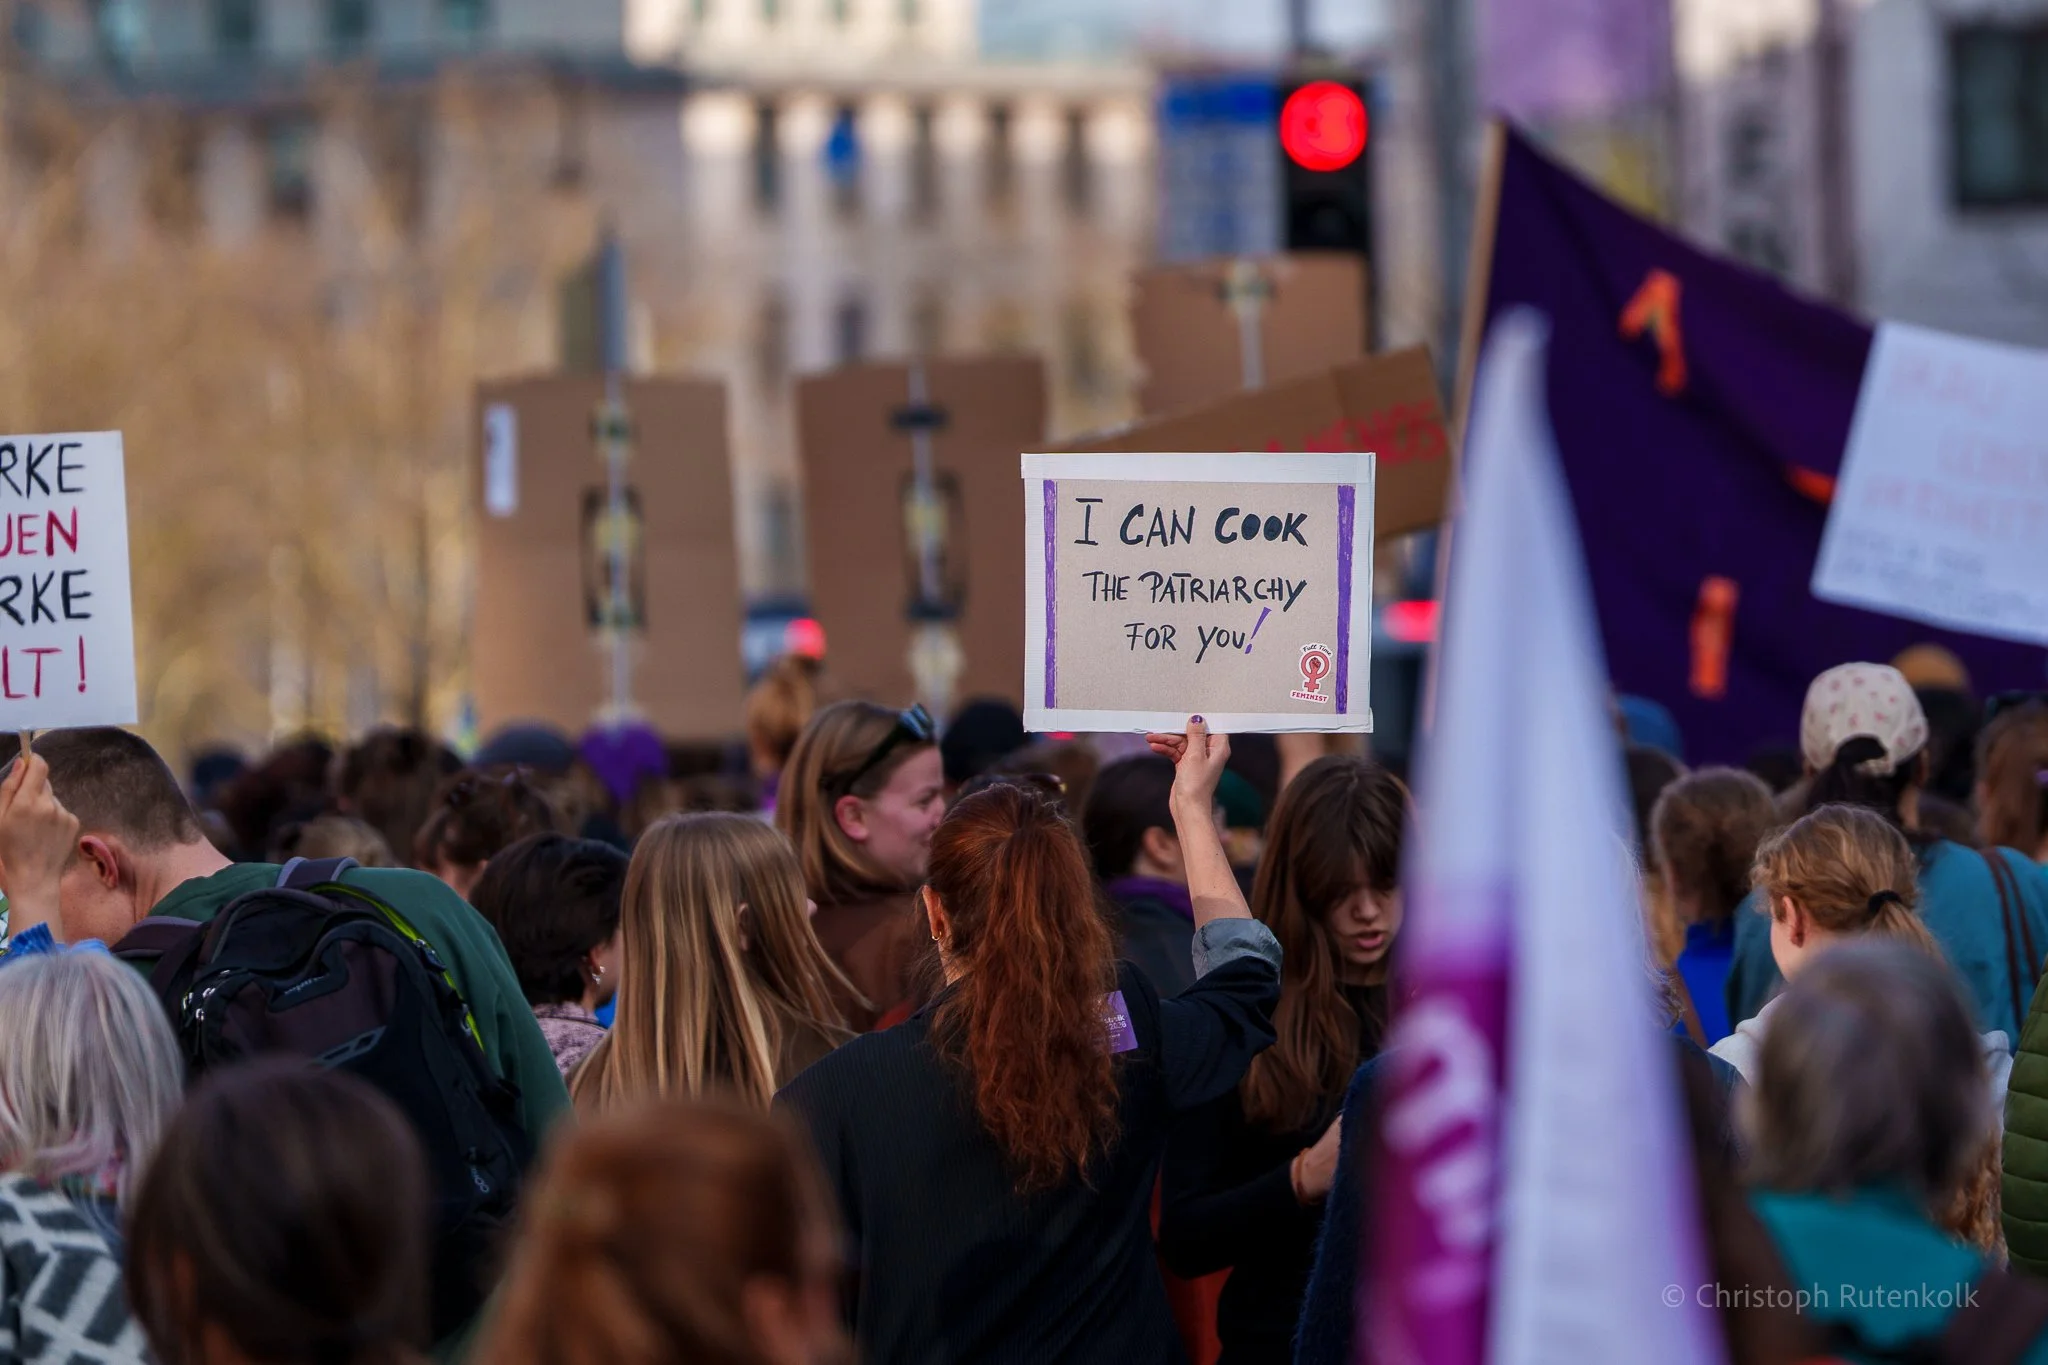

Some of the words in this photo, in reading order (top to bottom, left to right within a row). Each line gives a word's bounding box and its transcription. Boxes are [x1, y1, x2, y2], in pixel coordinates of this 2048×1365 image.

[1074, 498, 1103, 546] I
[1119, 504, 1196, 547] CAN
[1214, 507, 1308, 547] COOK
[1082, 571, 1131, 602] THE
[1138, 571, 1307, 612] PATRIARCHY
[1124, 623, 1177, 651] FOR
[1291, 691, 1328, 701] FEMINIST
